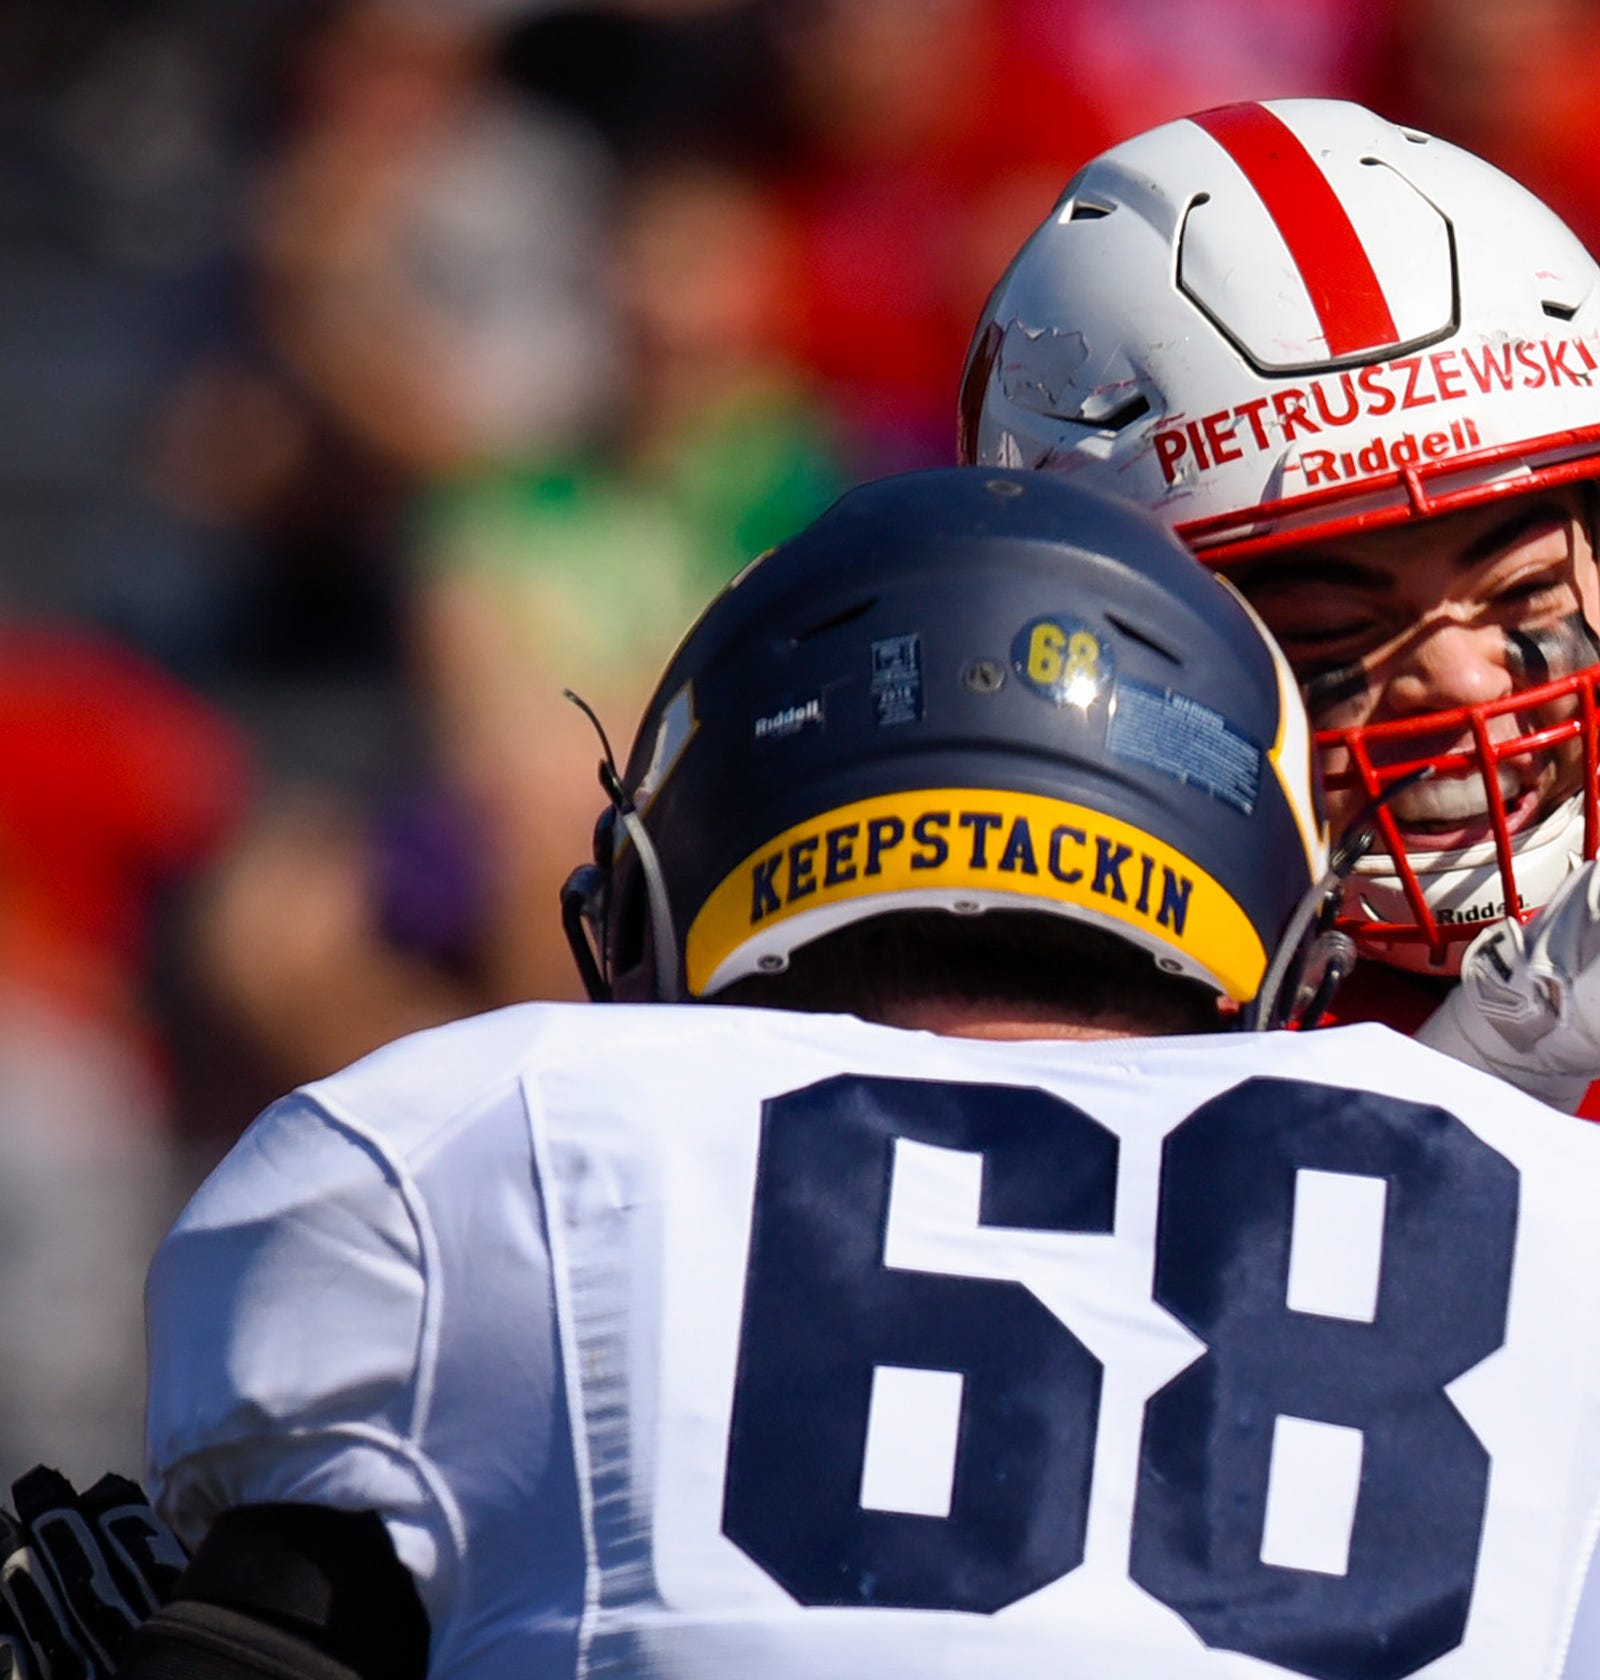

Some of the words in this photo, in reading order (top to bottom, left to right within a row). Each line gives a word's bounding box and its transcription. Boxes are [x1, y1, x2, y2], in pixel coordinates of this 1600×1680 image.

[1154, 338, 1598, 485] PIETRUSZEWSKI
[1300, 417, 1481, 486] Riddell
[1027, 623, 1099, 690] 68
[755, 699, 819, 738] Riddell
[749, 811, 1194, 938] KEEPSTACKIN
[721, 1072, 1522, 1680] 68
